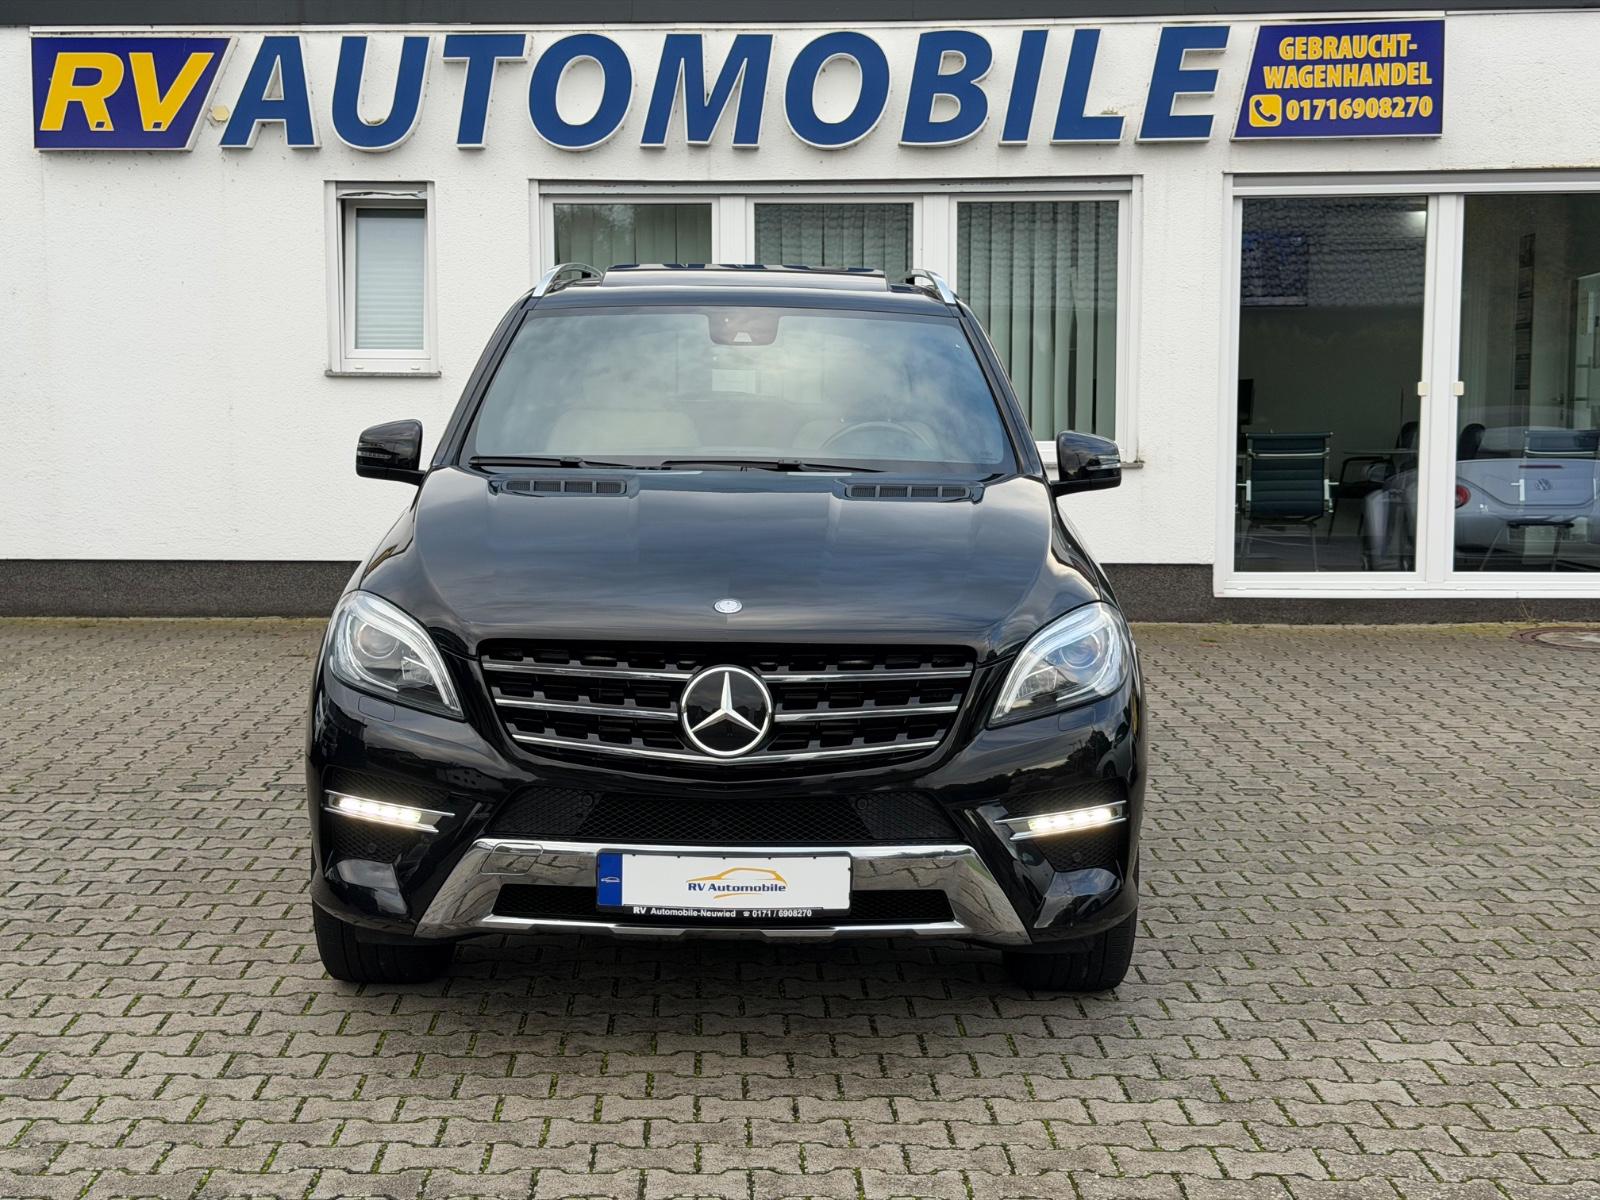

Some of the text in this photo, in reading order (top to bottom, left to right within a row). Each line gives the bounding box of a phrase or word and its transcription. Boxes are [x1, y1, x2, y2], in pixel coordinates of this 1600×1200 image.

[1279, 34, 1417, 60] GEBRAUCHT-
[219, 25, 1231, 151] AUTOMOBILE
[1263, 62, 1432, 89] WAGENHANDEL
[1286, 96, 1433, 121] 01716908270
[688, 883, 786, 892] RV Automobile
[633, 906, 736, 917] RV Automobile-Neuwied
[778, 909, 812, 917] 6908270
